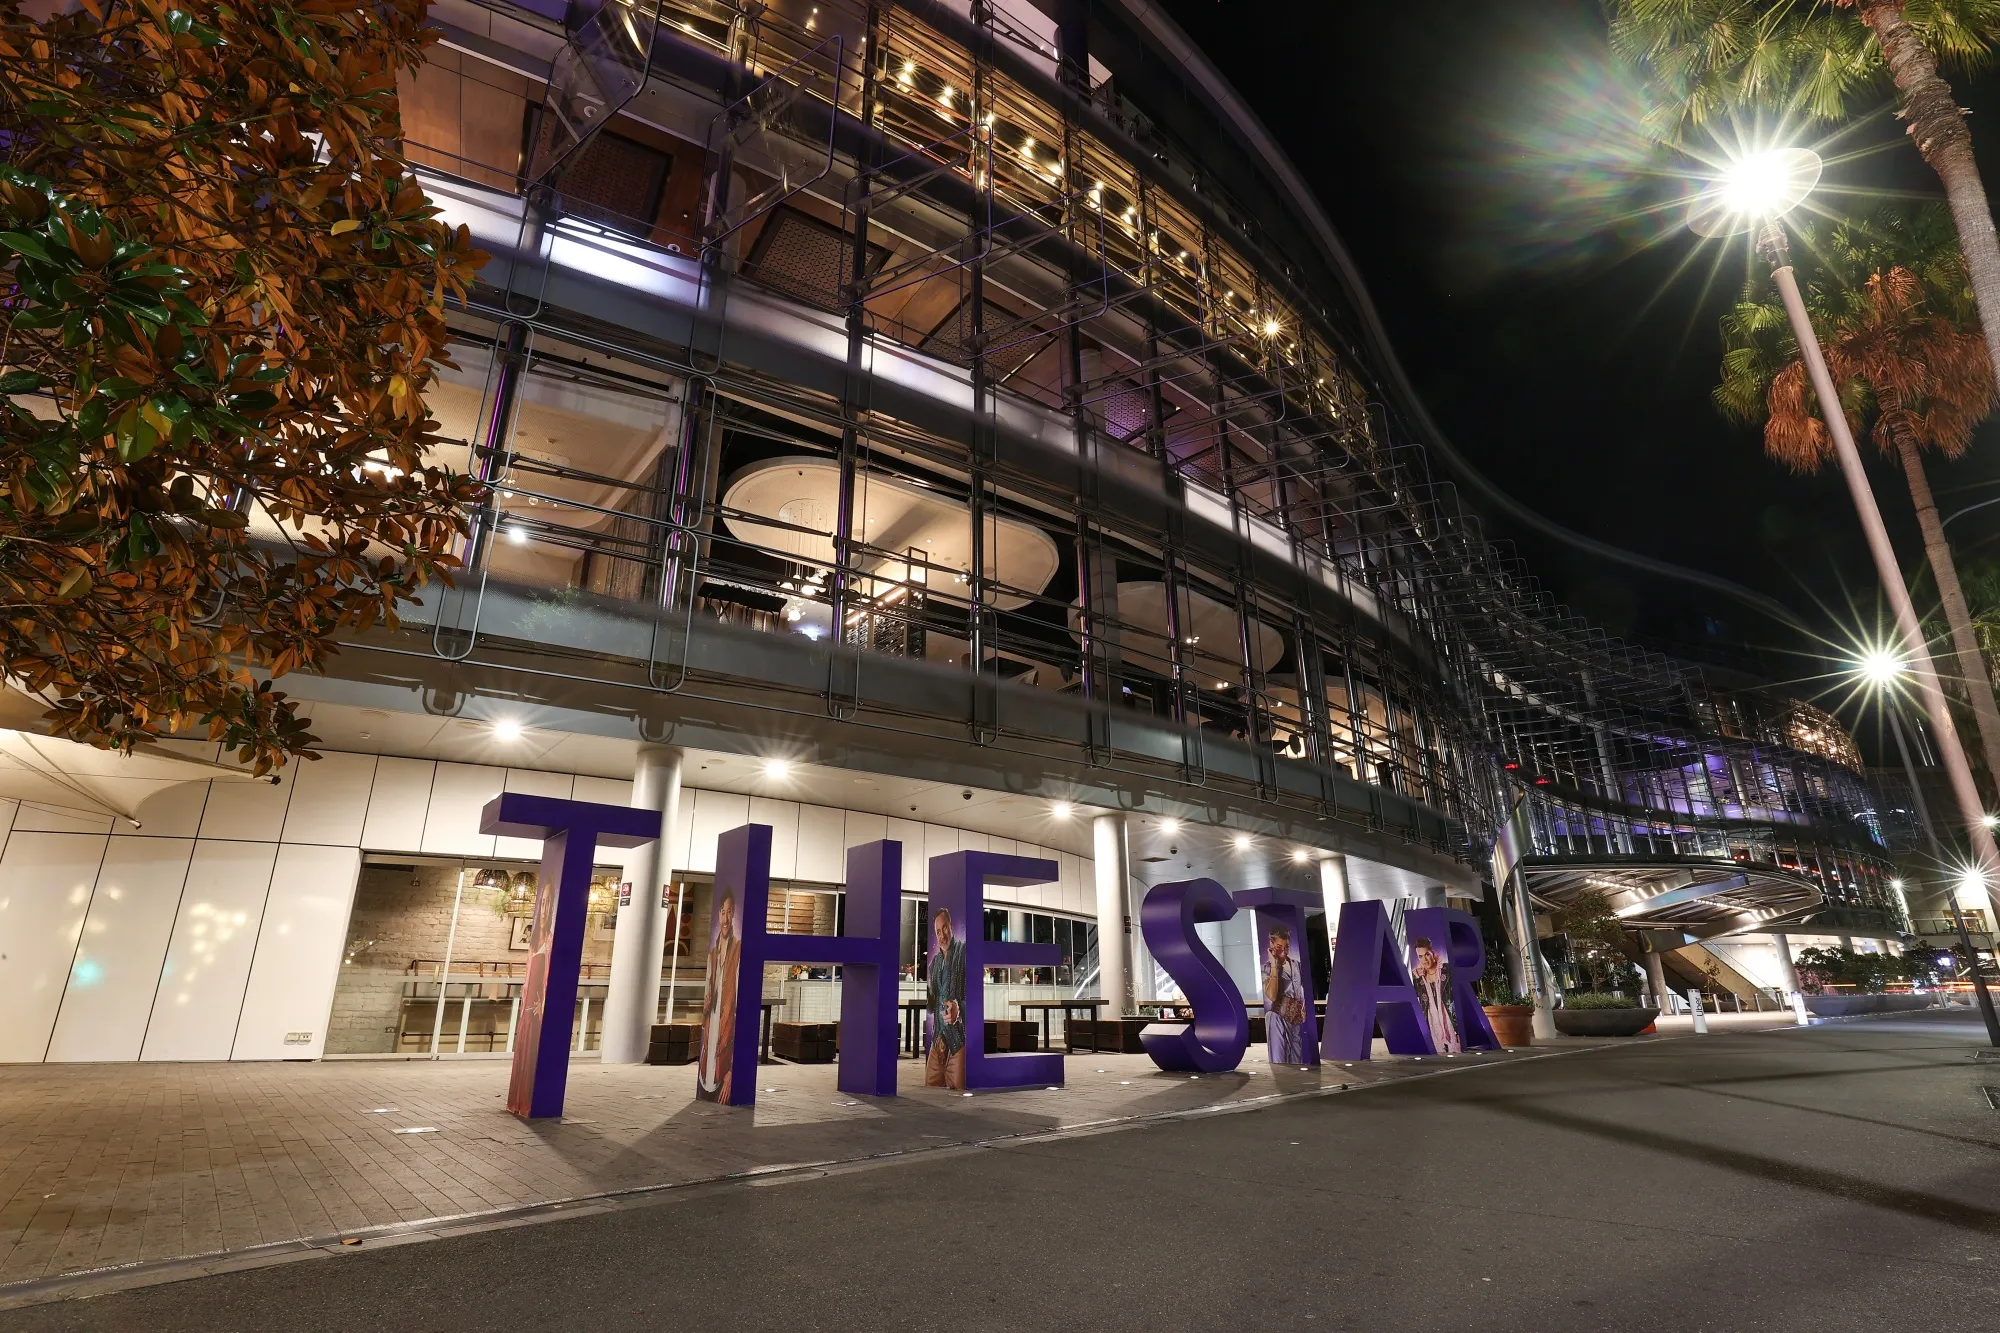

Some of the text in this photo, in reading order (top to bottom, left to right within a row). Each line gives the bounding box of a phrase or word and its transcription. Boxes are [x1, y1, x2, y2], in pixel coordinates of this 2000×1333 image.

[480, 791, 1503, 1119] THE STAR
[1695, 997, 1704, 1017] Uber
